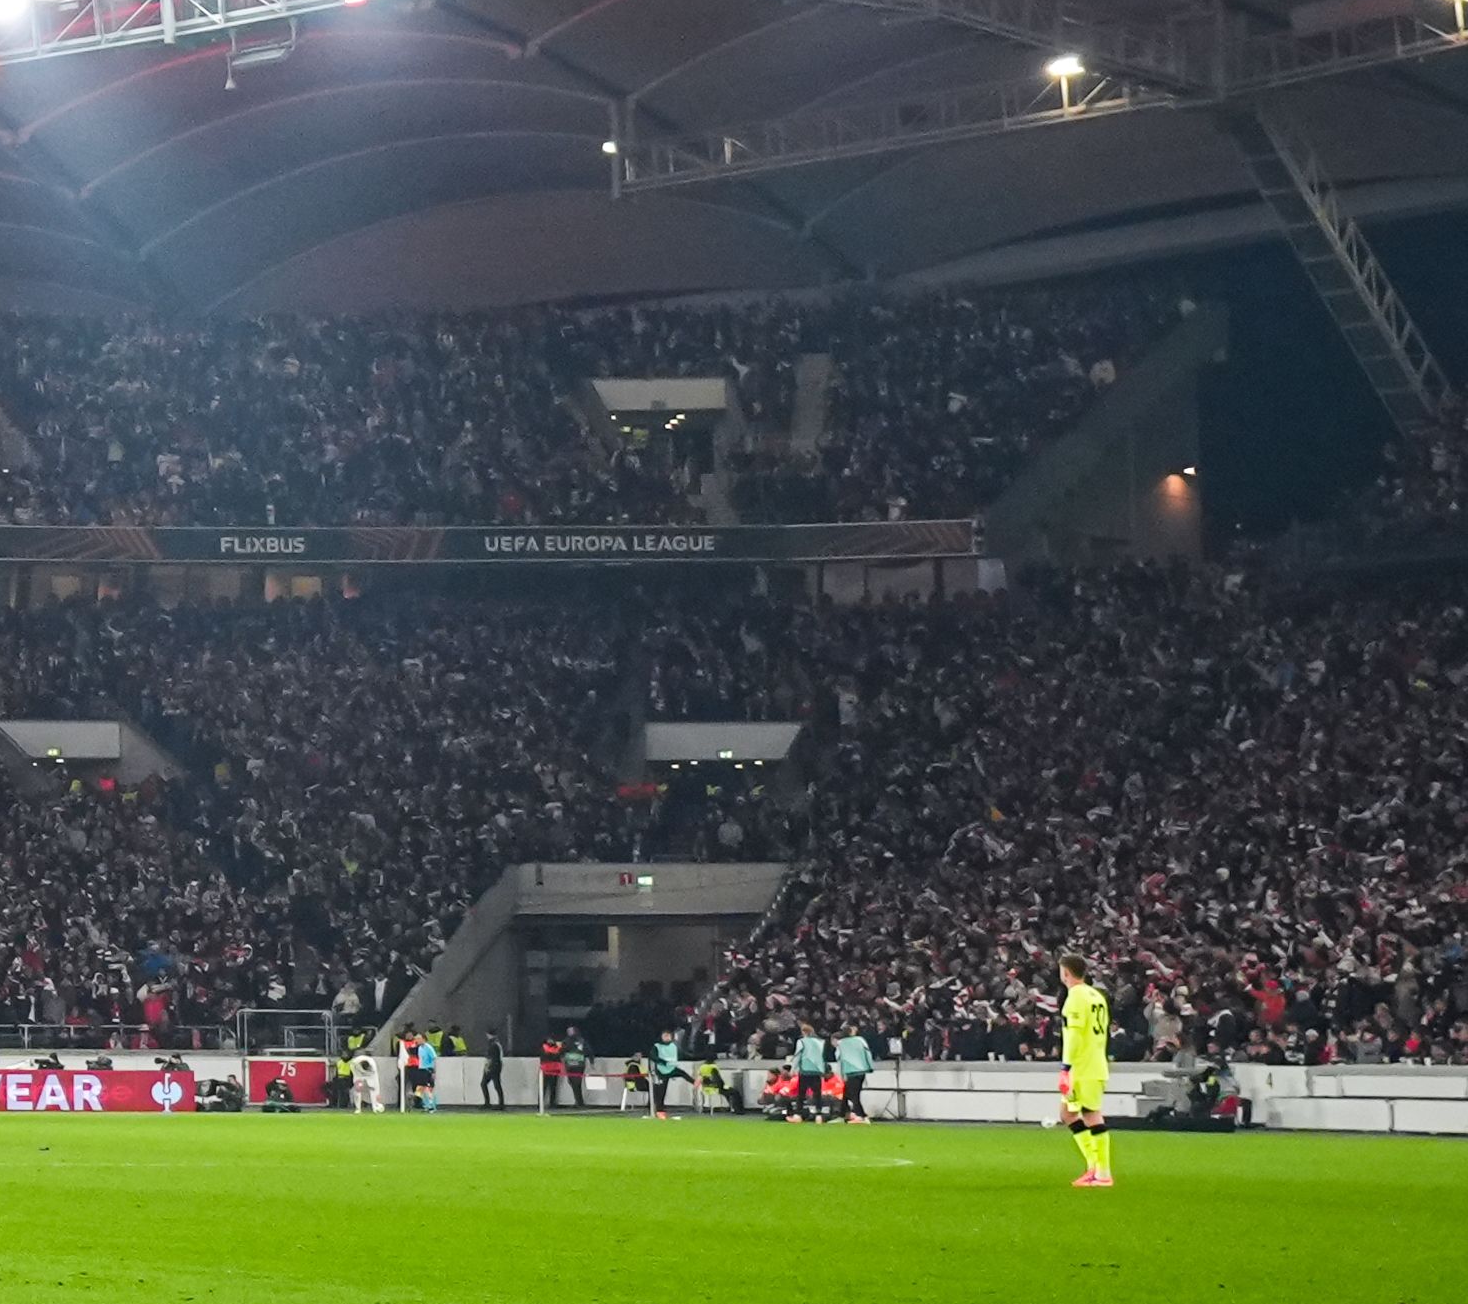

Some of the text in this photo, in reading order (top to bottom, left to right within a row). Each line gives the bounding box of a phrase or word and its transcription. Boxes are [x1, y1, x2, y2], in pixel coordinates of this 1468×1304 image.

[484, 535, 716, 552] UEFA EUROPA LEAGUE
[279, 1062, 297, 1077] 75
